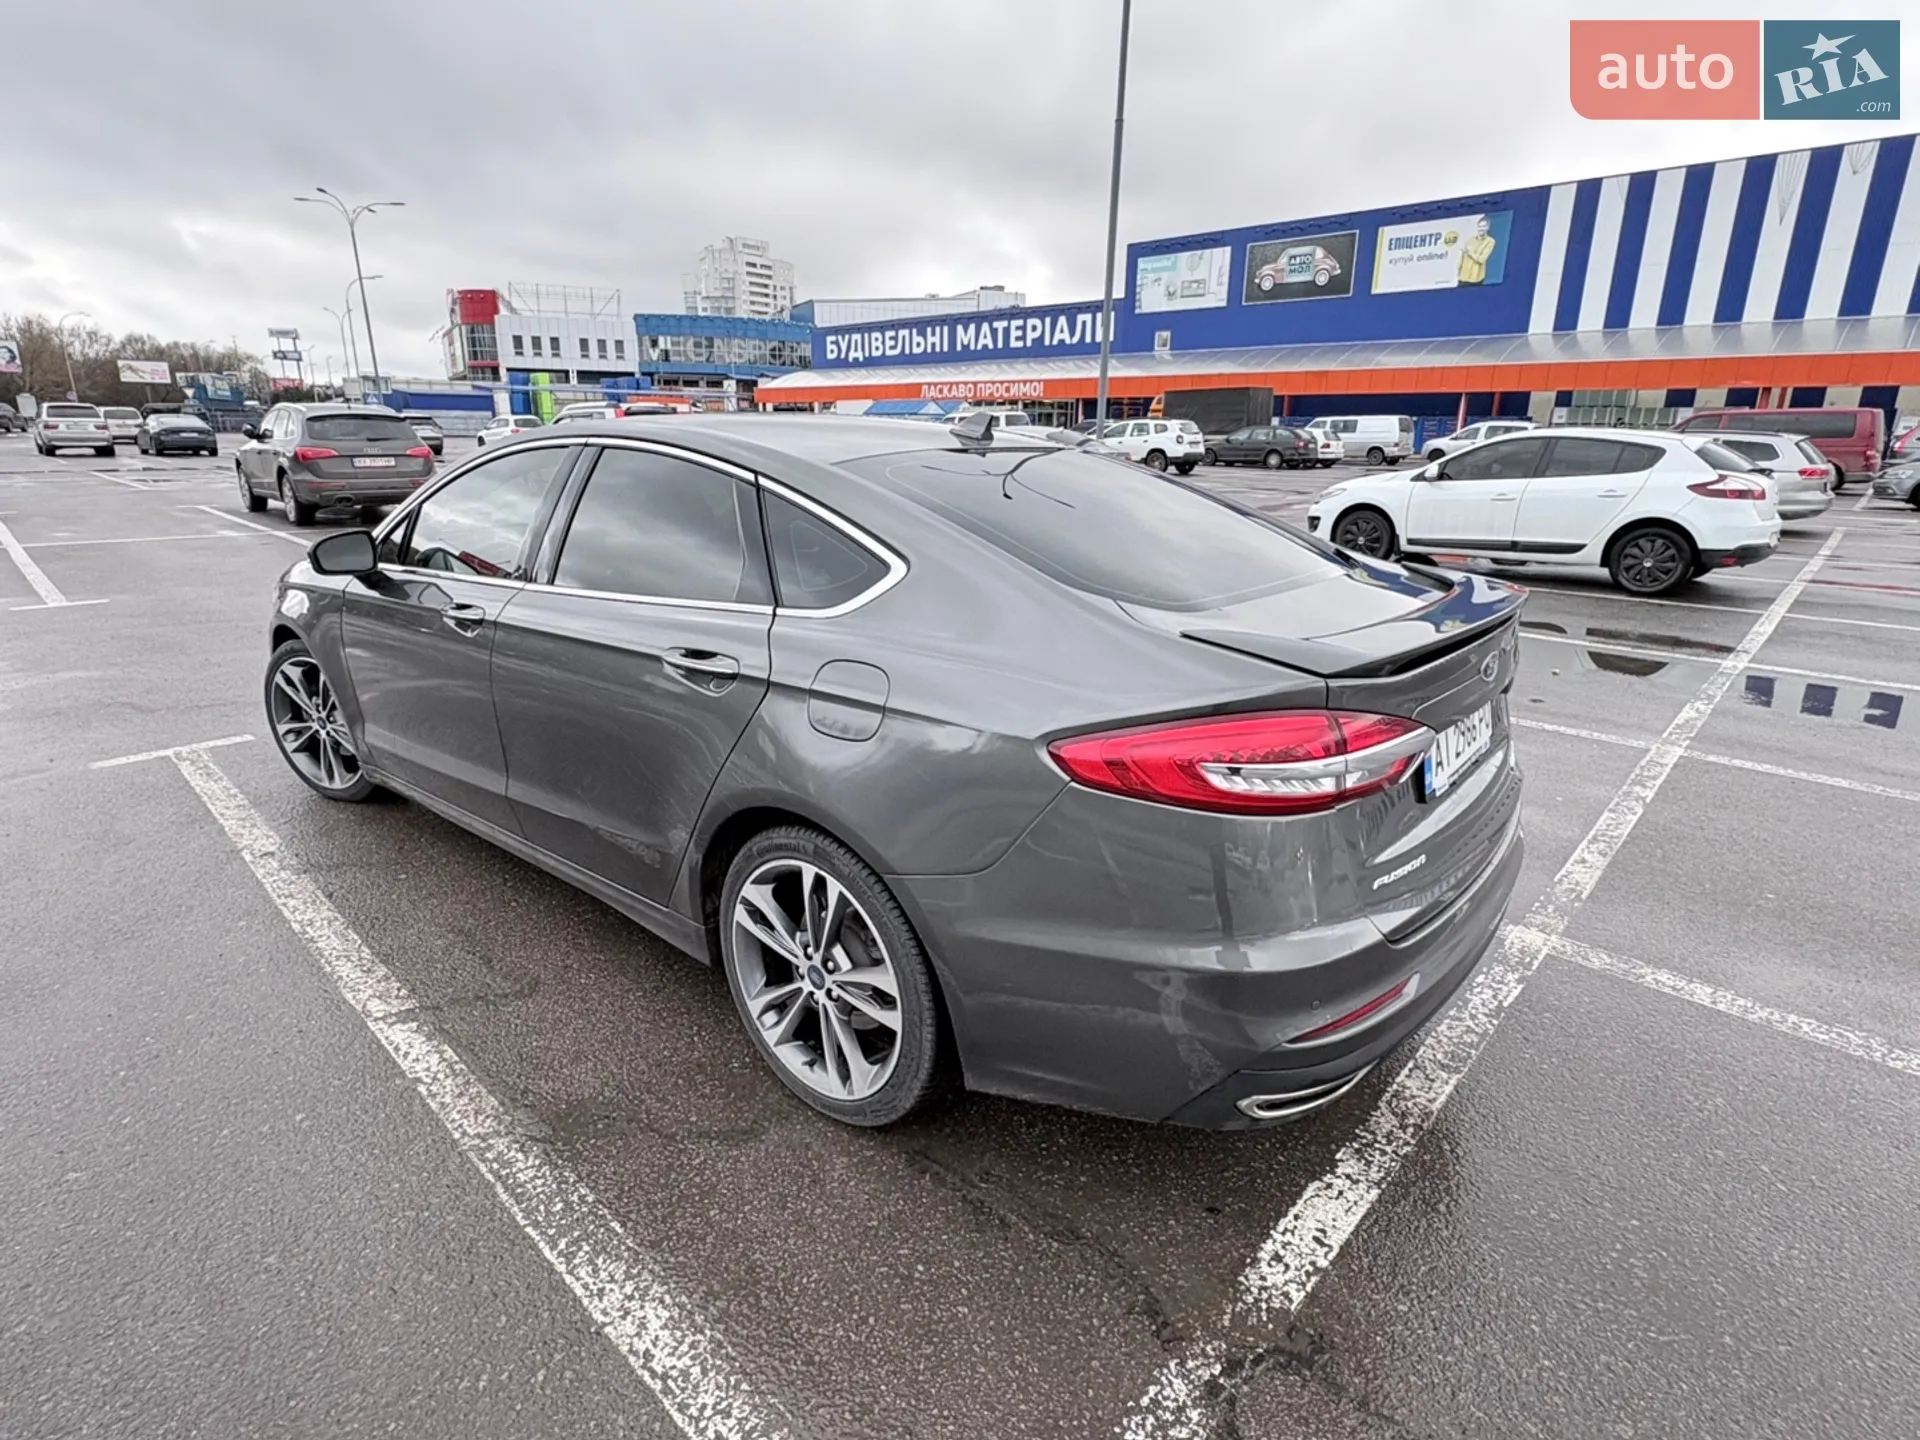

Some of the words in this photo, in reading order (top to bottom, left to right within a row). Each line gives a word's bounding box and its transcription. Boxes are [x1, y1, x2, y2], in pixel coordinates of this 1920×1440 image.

[1388, 232, 1442, 251] ЕПІЦЕНТР
[1416, 250, 1449, 262] online!
[826, 325, 948, 362] БУДІВЕЛЬНІ
[920, 384, 974, 398] ЛАСКАВО
[977, 381, 1044, 397] ПРОСИМО!
[1373, 854, 1426, 890] FUSION
